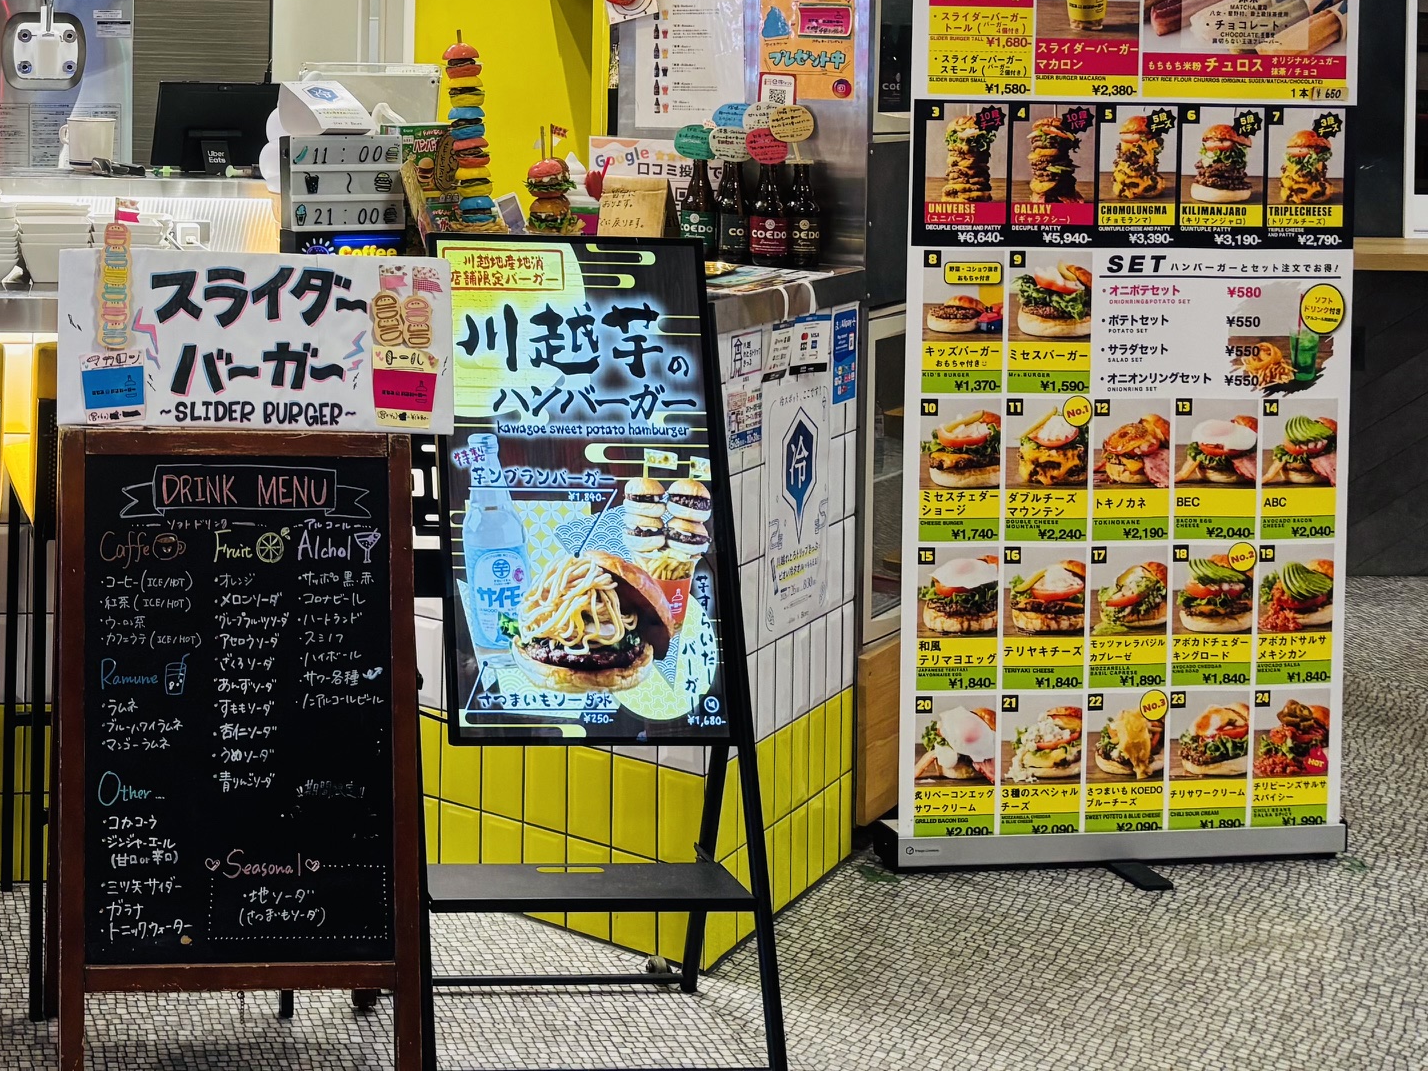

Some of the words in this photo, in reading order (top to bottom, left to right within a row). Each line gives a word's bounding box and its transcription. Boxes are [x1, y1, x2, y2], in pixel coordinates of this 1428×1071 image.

[986, 37, 1032, 49] ¥1,680-
[1037, 59, 1083, 70] マカロン
[1204, 57, 1264, 73] チュロス
[985, 83, 1031, 95] ¥1,580-
[1092, 84, 1137, 97] ¥2,380-
[207, 149, 226, 158] Uber
[208, 156, 227, 165] Eats
[928, 203, 976, 214] UNIVERSE
[1014, 203, 1052, 215] GALAXY
[1100, 205, 1167, 216] CHOMOLUNGMA
[1181, 206, 1247, 217] KILIMANJARO
[1268, 206, 1332, 217] TRIPLECHEESE
[751, 229, 787, 239] COEDO
[957, 232, 1004, 244] ¥6,640-
[1042, 232, 1092, 244] ¥5,940-
[1129, 233, 1174, 245] ¥3,390-
[1214, 234, 1262, 246] ¥3,190-
[1298, 234, 1342, 246] ¥2,790-
[462, 253, 545, 270] 川越地産地消
[1106, 254, 1167, 274] SET
[1227, 286, 1262, 298] ¥580
[1108, 314, 1169, 326] ポテトセット
[1226, 316, 1261, 328] ¥550
[456, 302, 690, 378] 川越芋の
[1009, 349, 1088, 361] ミセスバーガー
[1108, 343, 1168, 355] サラダセット
[493, 384, 697, 421] ハンバーガー
[1066, 406, 1091, 420] No.1
[497, 421, 547, 436] kawagoe
[550, 424, 583, 436] sweet
[586, 423, 625, 437] potato
[628, 422, 689, 438] hamburger
[789, 435, 809, 490] 冷
[162, 474, 238, 506] DRINK
[257, 474, 328, 507] MENU
[1095, 497, 1147, 509] トキノカネ
[1176, 497, 1201, 508] BEC
[1263, 497, 1287, 508] ABC
[99, 530, 150, 569] Caffe
[213, 529, 253, 563] Fruit
[297, 533, 352, 560] Alchol
[1004, 645, 1083, 657] テリヤキチーズ
[100, 658, 159, 690] Ramune
[583, 713, 614, 724] ¥250-
[223, 849, 302, 879] Seasonal
